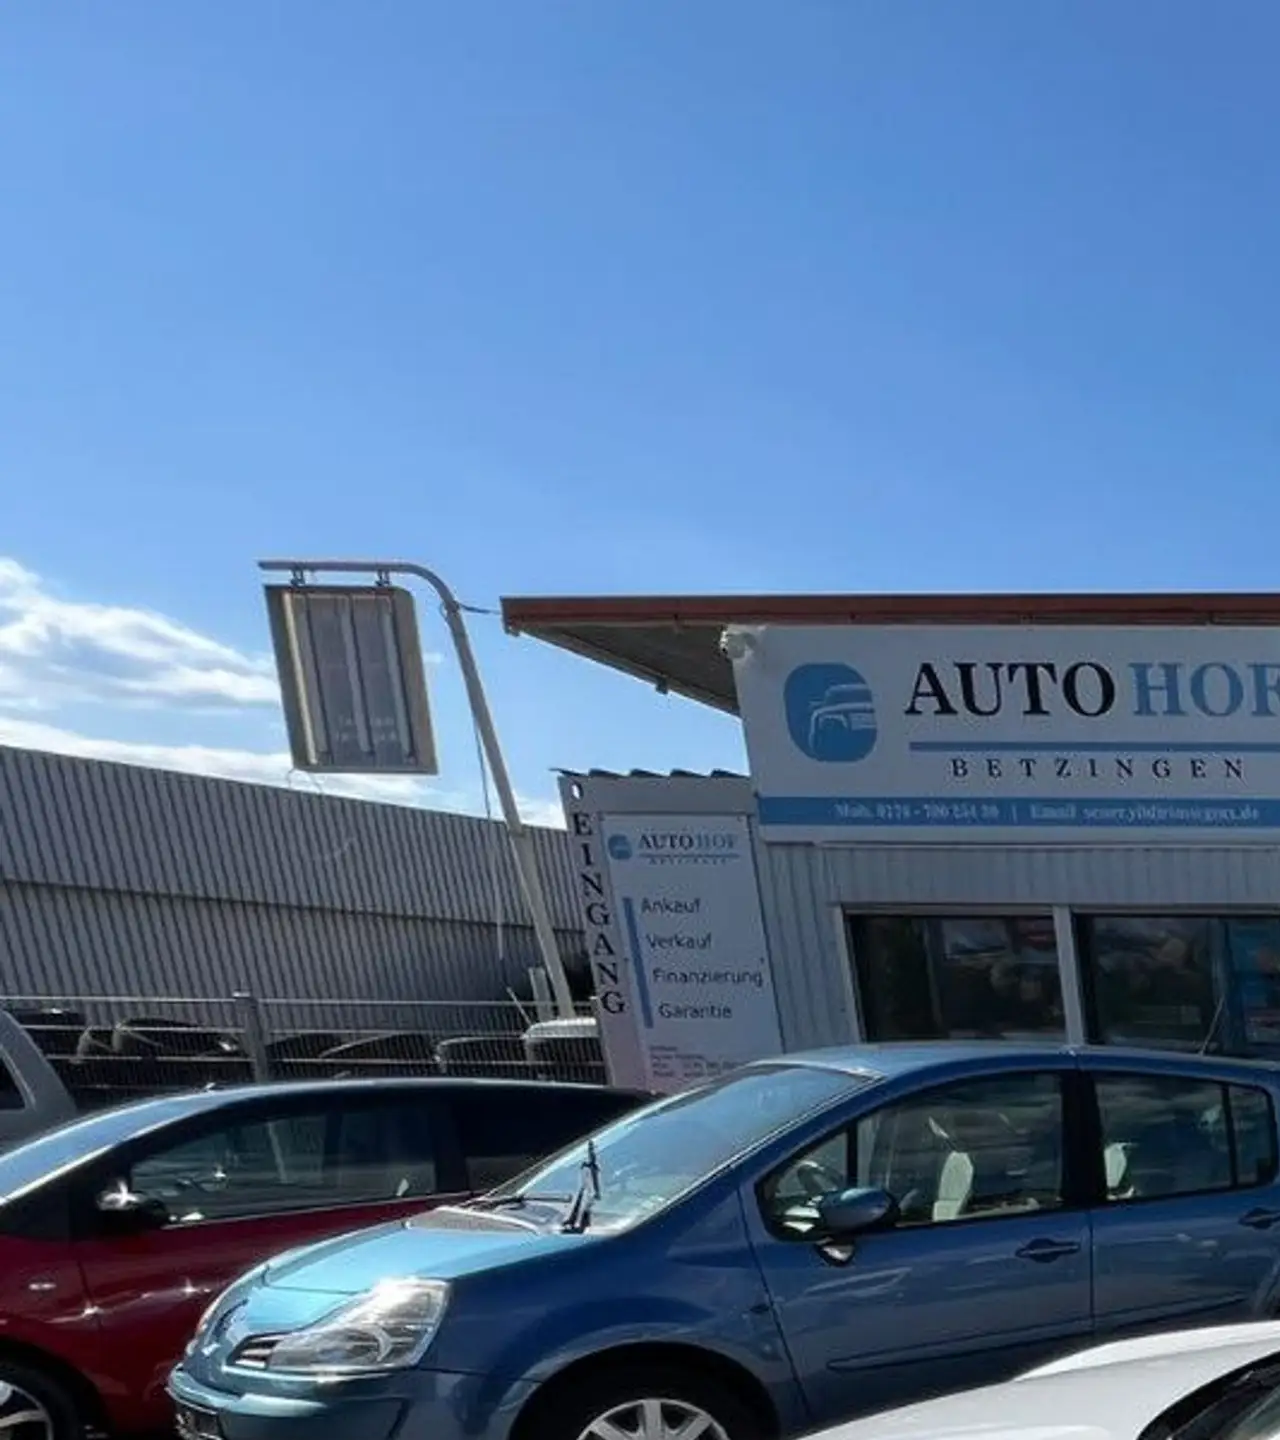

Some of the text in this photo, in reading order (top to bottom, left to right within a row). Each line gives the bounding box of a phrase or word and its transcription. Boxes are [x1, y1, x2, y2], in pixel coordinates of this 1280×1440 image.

[904, 661, 1116, 717] AUTO
[951, 757, 1246, 779] BETZINGEN
[639, 833, 694, 850] AUTO
[572, 812, 626, 1015] EINGANG
[641, 897, 701, 915] Ankauf
[645, 932, 712, 950] Verkauf
[652, 966, 764, 987] Finanzierung
[657, 1002, 733, 1020] Garantie
